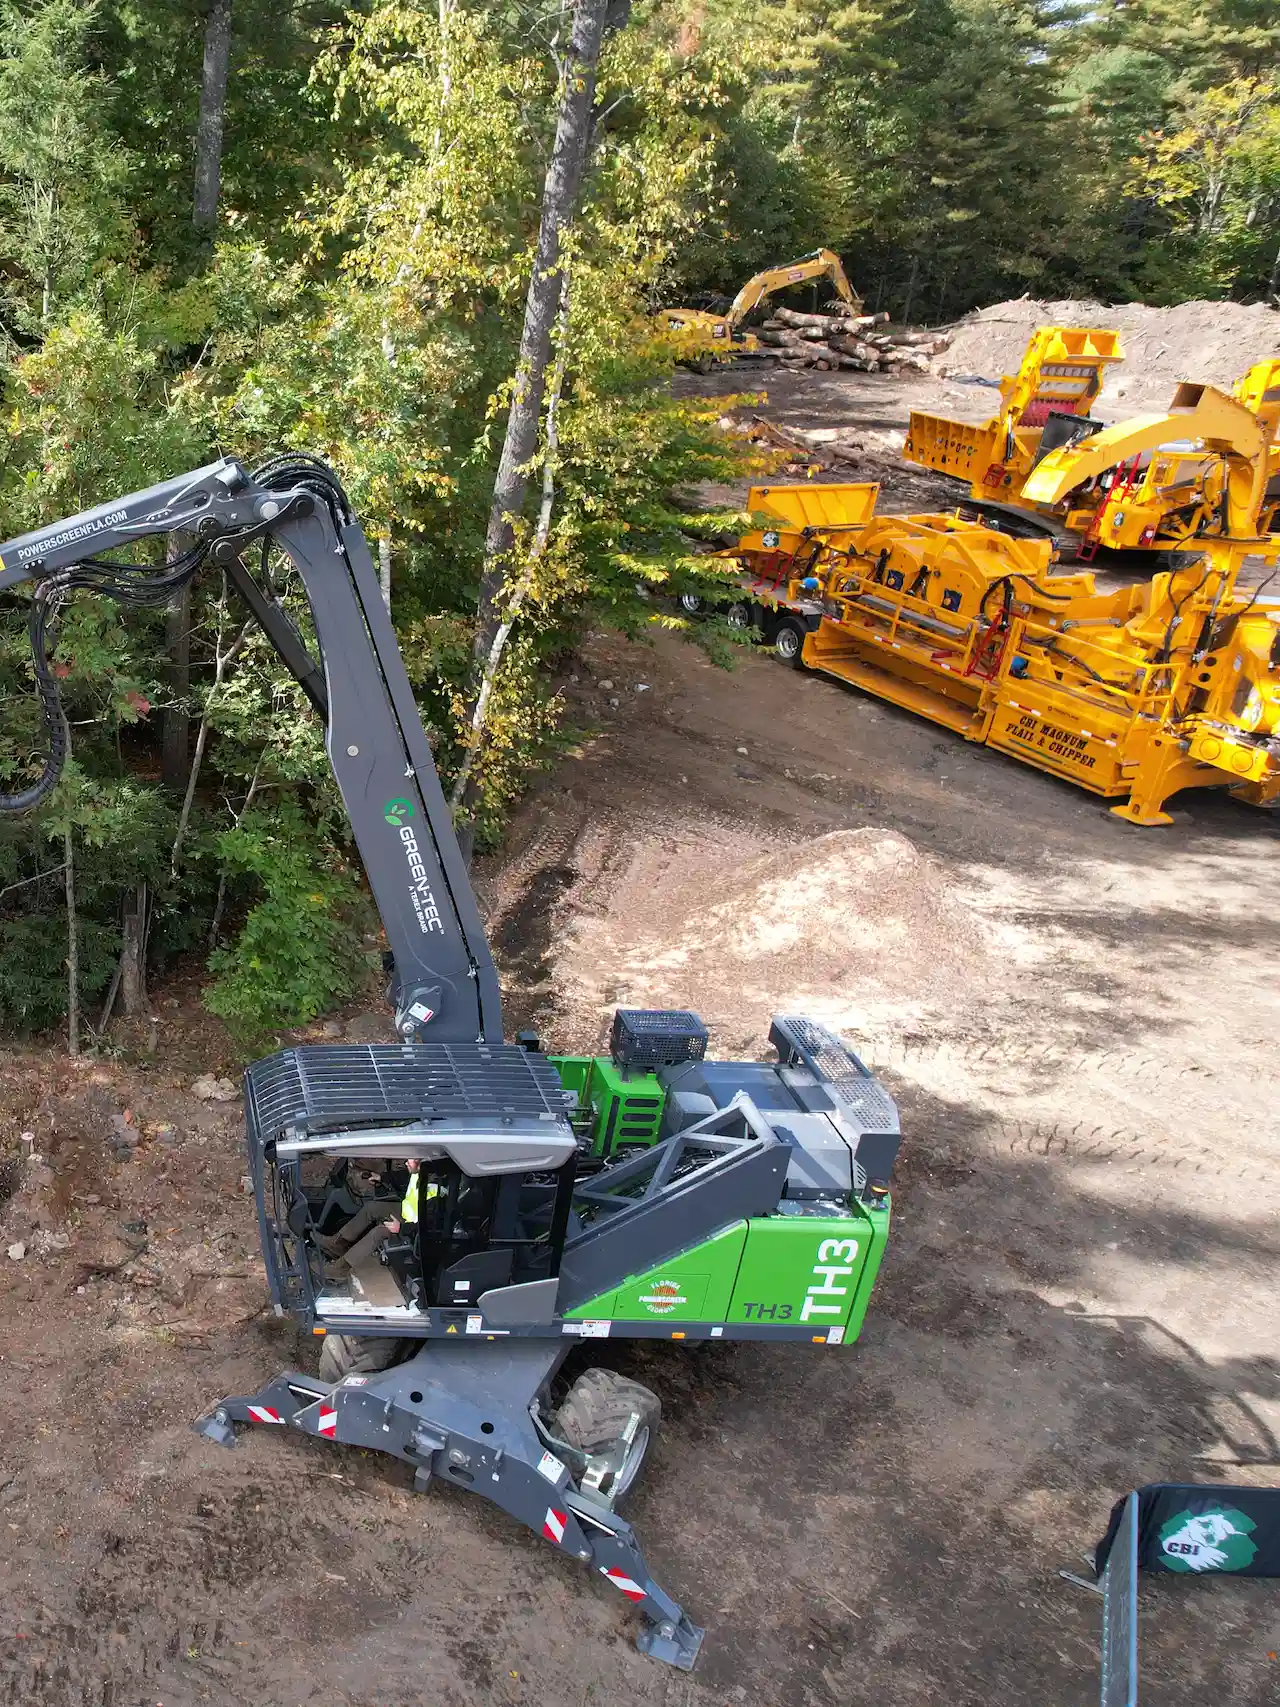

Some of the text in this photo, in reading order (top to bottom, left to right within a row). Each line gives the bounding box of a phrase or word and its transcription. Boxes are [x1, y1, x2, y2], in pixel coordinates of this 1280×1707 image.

[17, 510, 128, 560] POWERSCREENFLA.COM
[1004, 723, 1096, 768] FLAIL & CHIPPER
[1040, 724, 1088, 750] MAGNUM
[399, 826, 443, 932] GREEN-TEC
[410, 891, 421, 912] TEREX
[416, 911, 429, 934] BRAND
[799, 1239, 859, 1321] TH3
[743, 1303, 793, 1320] TH3
[1167, 1542, 1199, 1555] CBI
